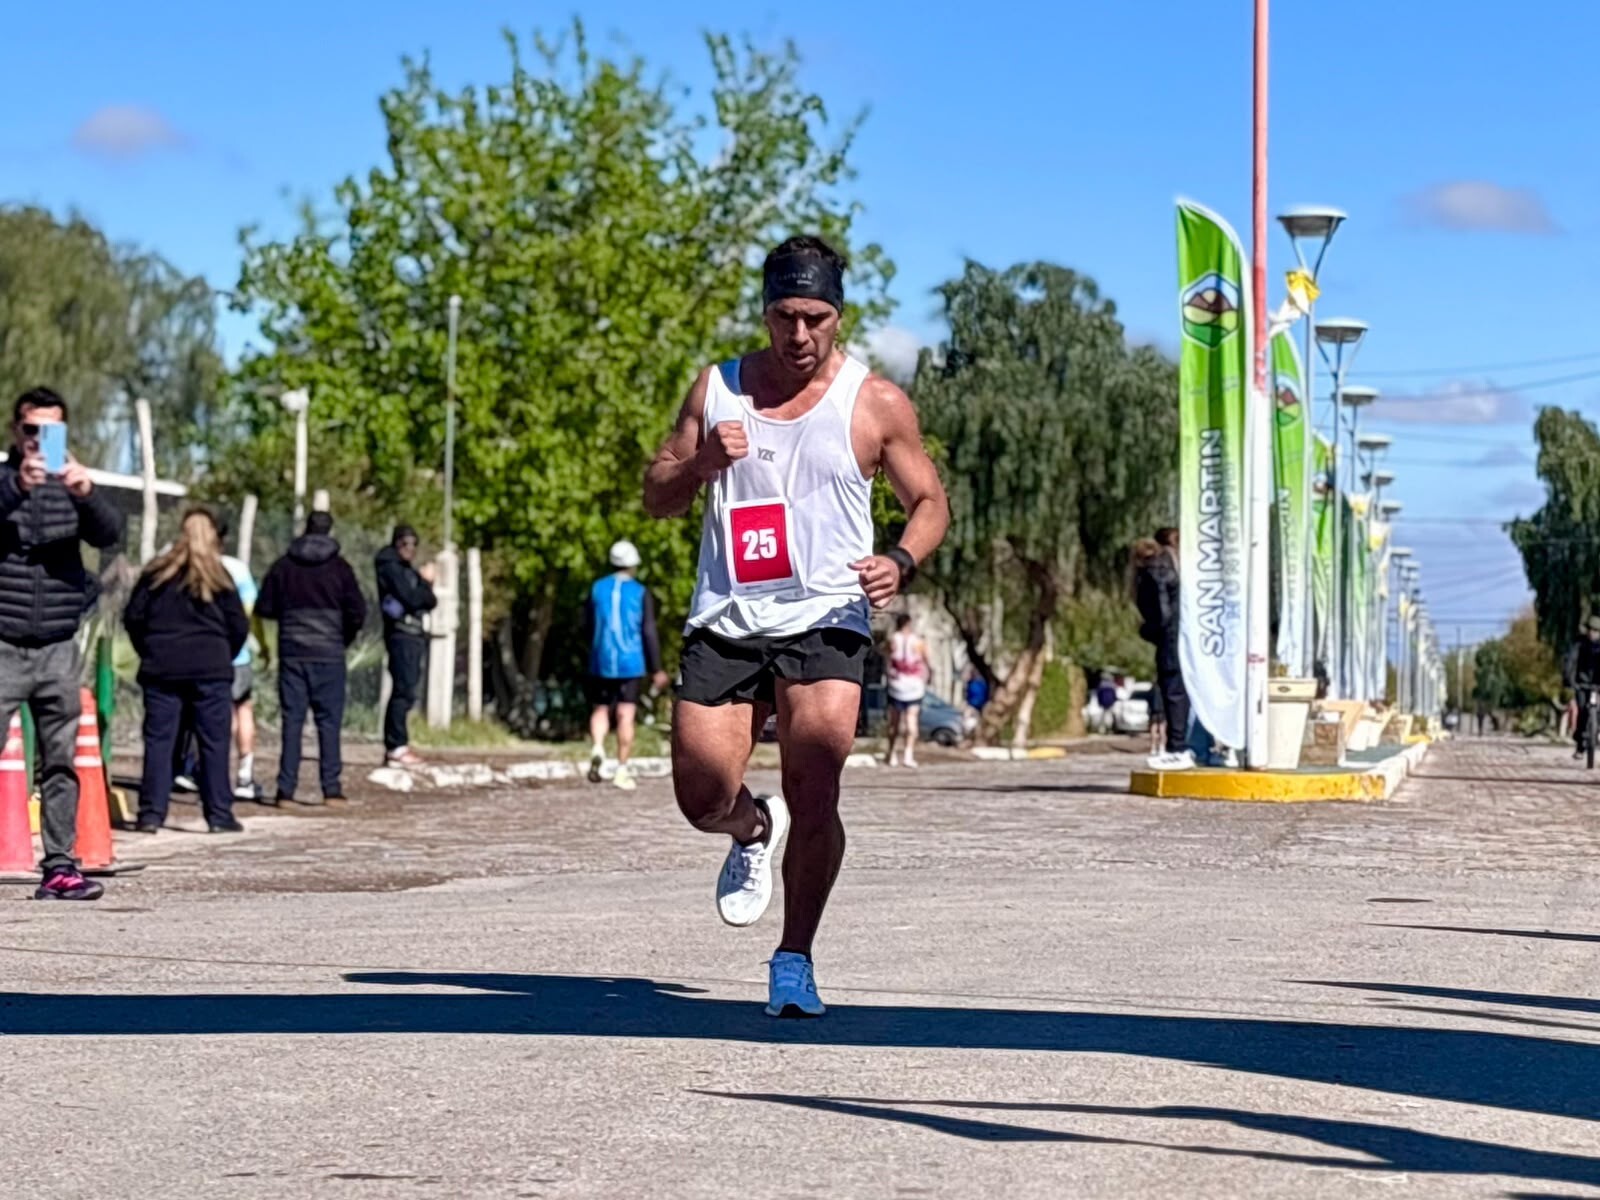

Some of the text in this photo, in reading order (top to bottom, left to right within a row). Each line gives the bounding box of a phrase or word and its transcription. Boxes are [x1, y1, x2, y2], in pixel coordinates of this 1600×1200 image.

[741, 527, 778, 561] 25
[1198, 429, 1225, 657] SAN MARTIN
